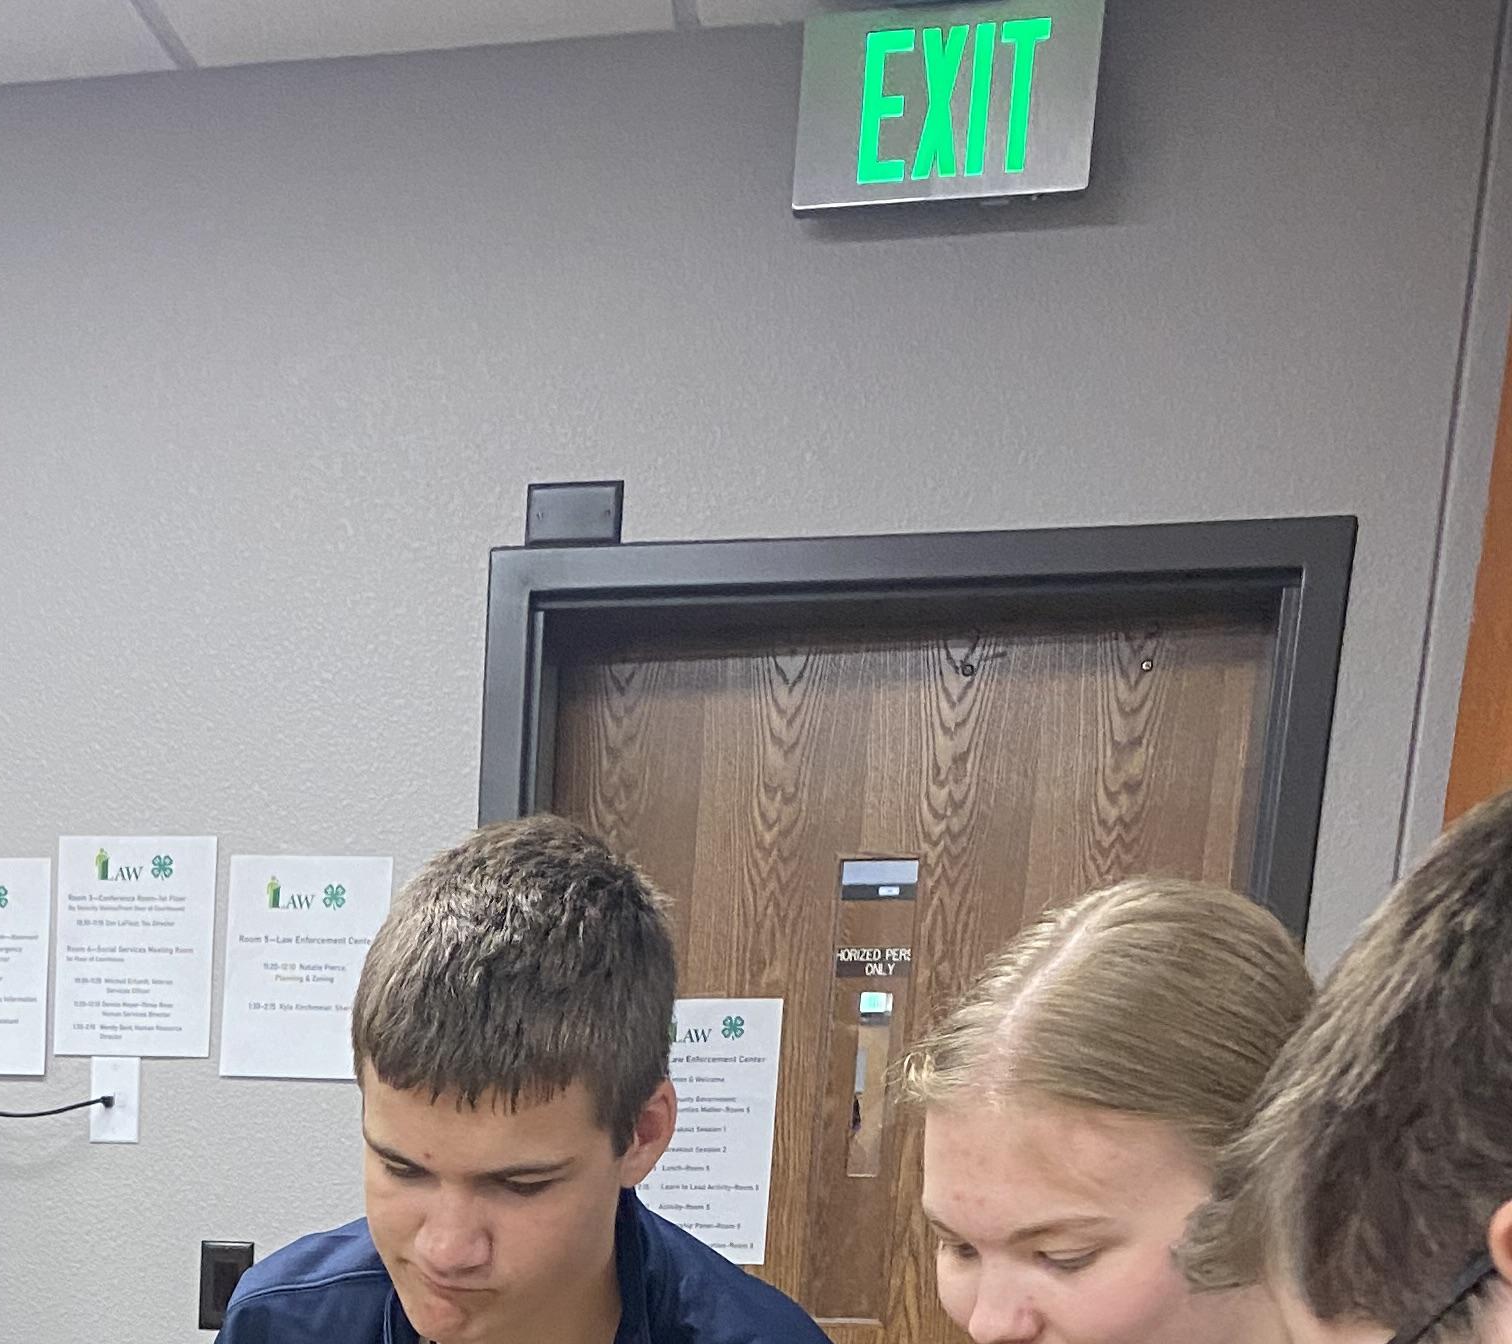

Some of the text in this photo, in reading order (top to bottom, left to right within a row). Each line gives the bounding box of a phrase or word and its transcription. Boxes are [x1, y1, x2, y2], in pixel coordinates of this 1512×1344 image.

[856, 17, 1051, 185] EXIT
[239, 935, 262, 943] Room
[295, 936, 347, 945] Enforcement
[348, 937, 372, 945] Cente
[865, 962, 896, 976] ONLY
[686, 1055, 736, 1063] Enforcement
